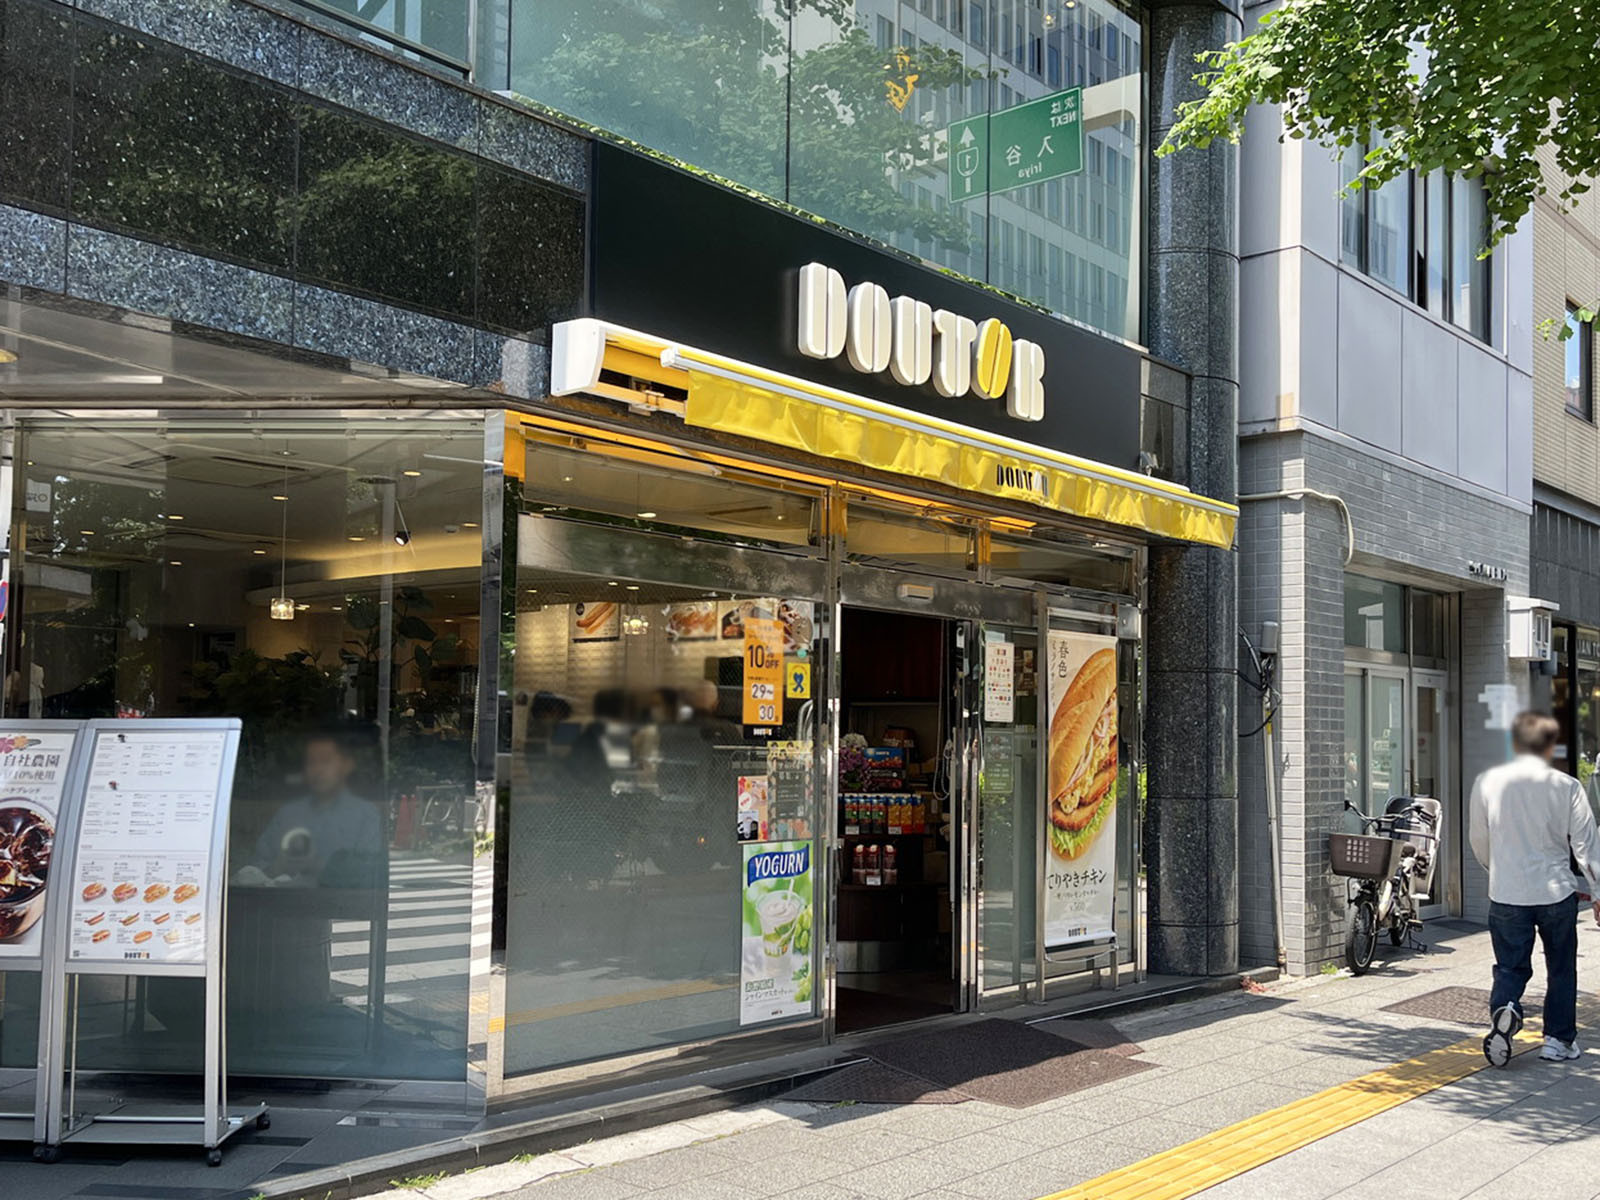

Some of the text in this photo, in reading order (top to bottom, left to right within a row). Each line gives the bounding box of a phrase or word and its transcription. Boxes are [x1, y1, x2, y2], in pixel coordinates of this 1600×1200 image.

[798, 261, 1045, 422] DOUTOR
[748, 644, 765, 669] 10
[765, 659, 780, 670] OFF
[759, 704, 775, 720] 30
[4, 753, 60, 768] 自社農園
[755, 852, 805, 878] YOGURN
